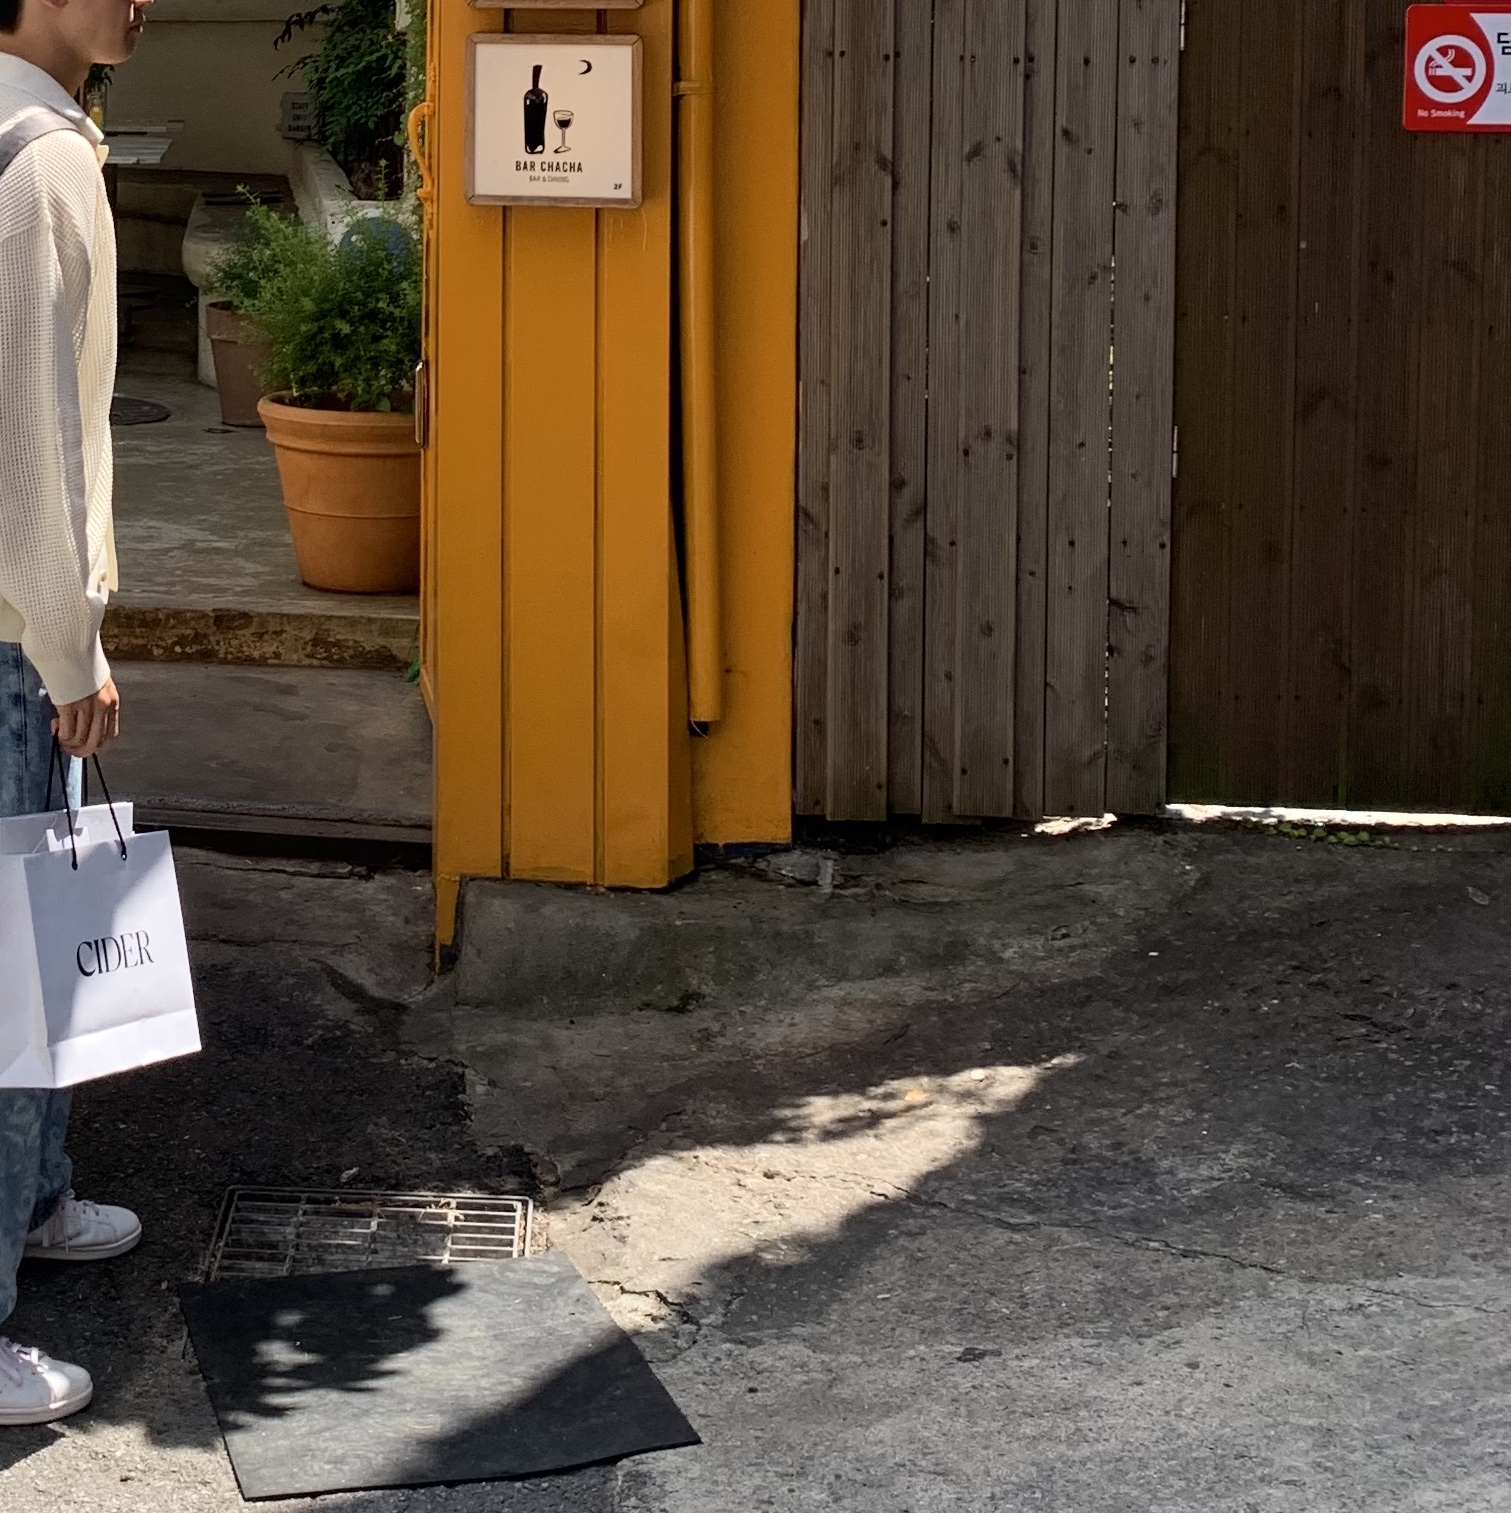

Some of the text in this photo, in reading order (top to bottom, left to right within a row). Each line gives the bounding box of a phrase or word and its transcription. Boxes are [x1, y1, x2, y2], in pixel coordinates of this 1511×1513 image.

[1417, 109, 1466, 119] No Smoking
[515, 160, 583, 173] BAR CHACHA
[76, 930, 155, 977] CIDER
